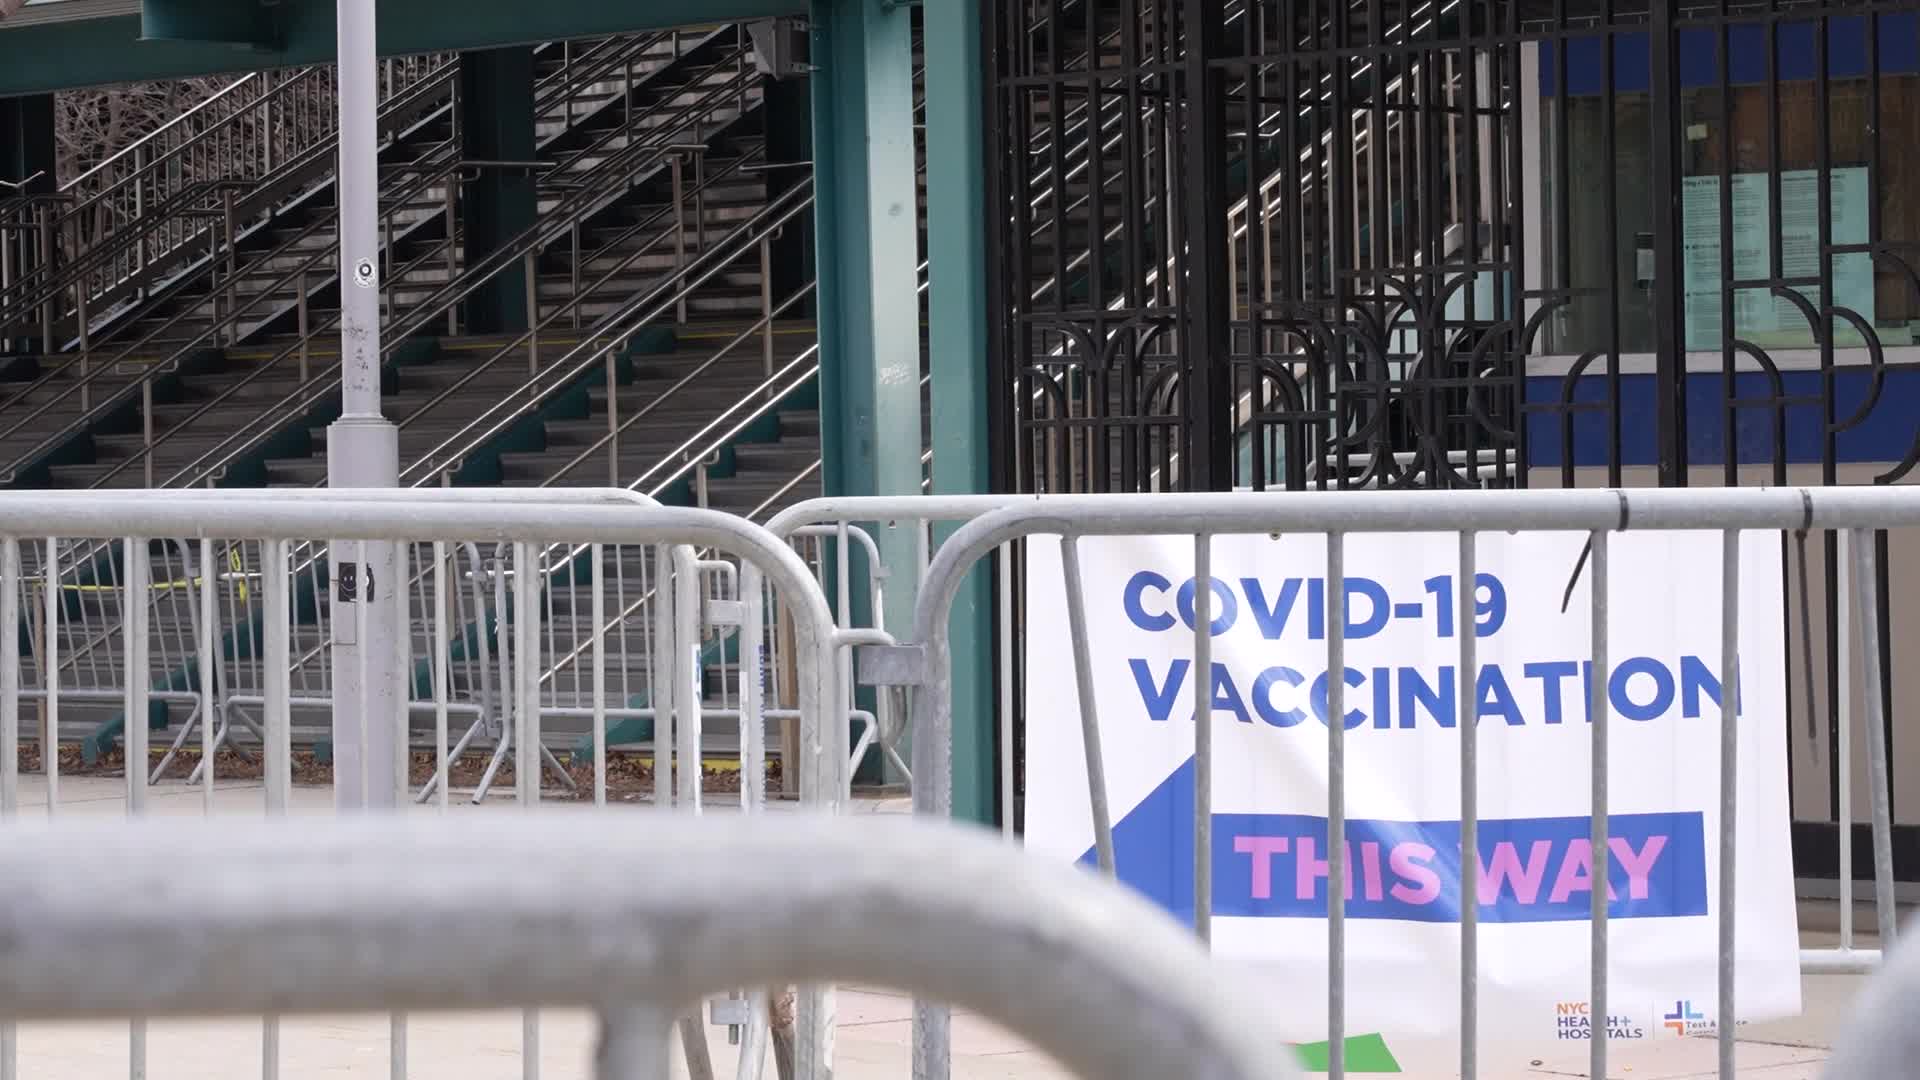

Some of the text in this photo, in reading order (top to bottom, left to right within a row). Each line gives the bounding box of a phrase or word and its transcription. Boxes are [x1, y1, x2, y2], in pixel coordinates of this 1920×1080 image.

[1123, 571, 1507, 640] COVID-19
[1234, 835, 1668, 906] THIS WAY
[1557, 1003, 1589, 1015] NYC
[1558, 1028, 1643, 1039] HOSTALS
